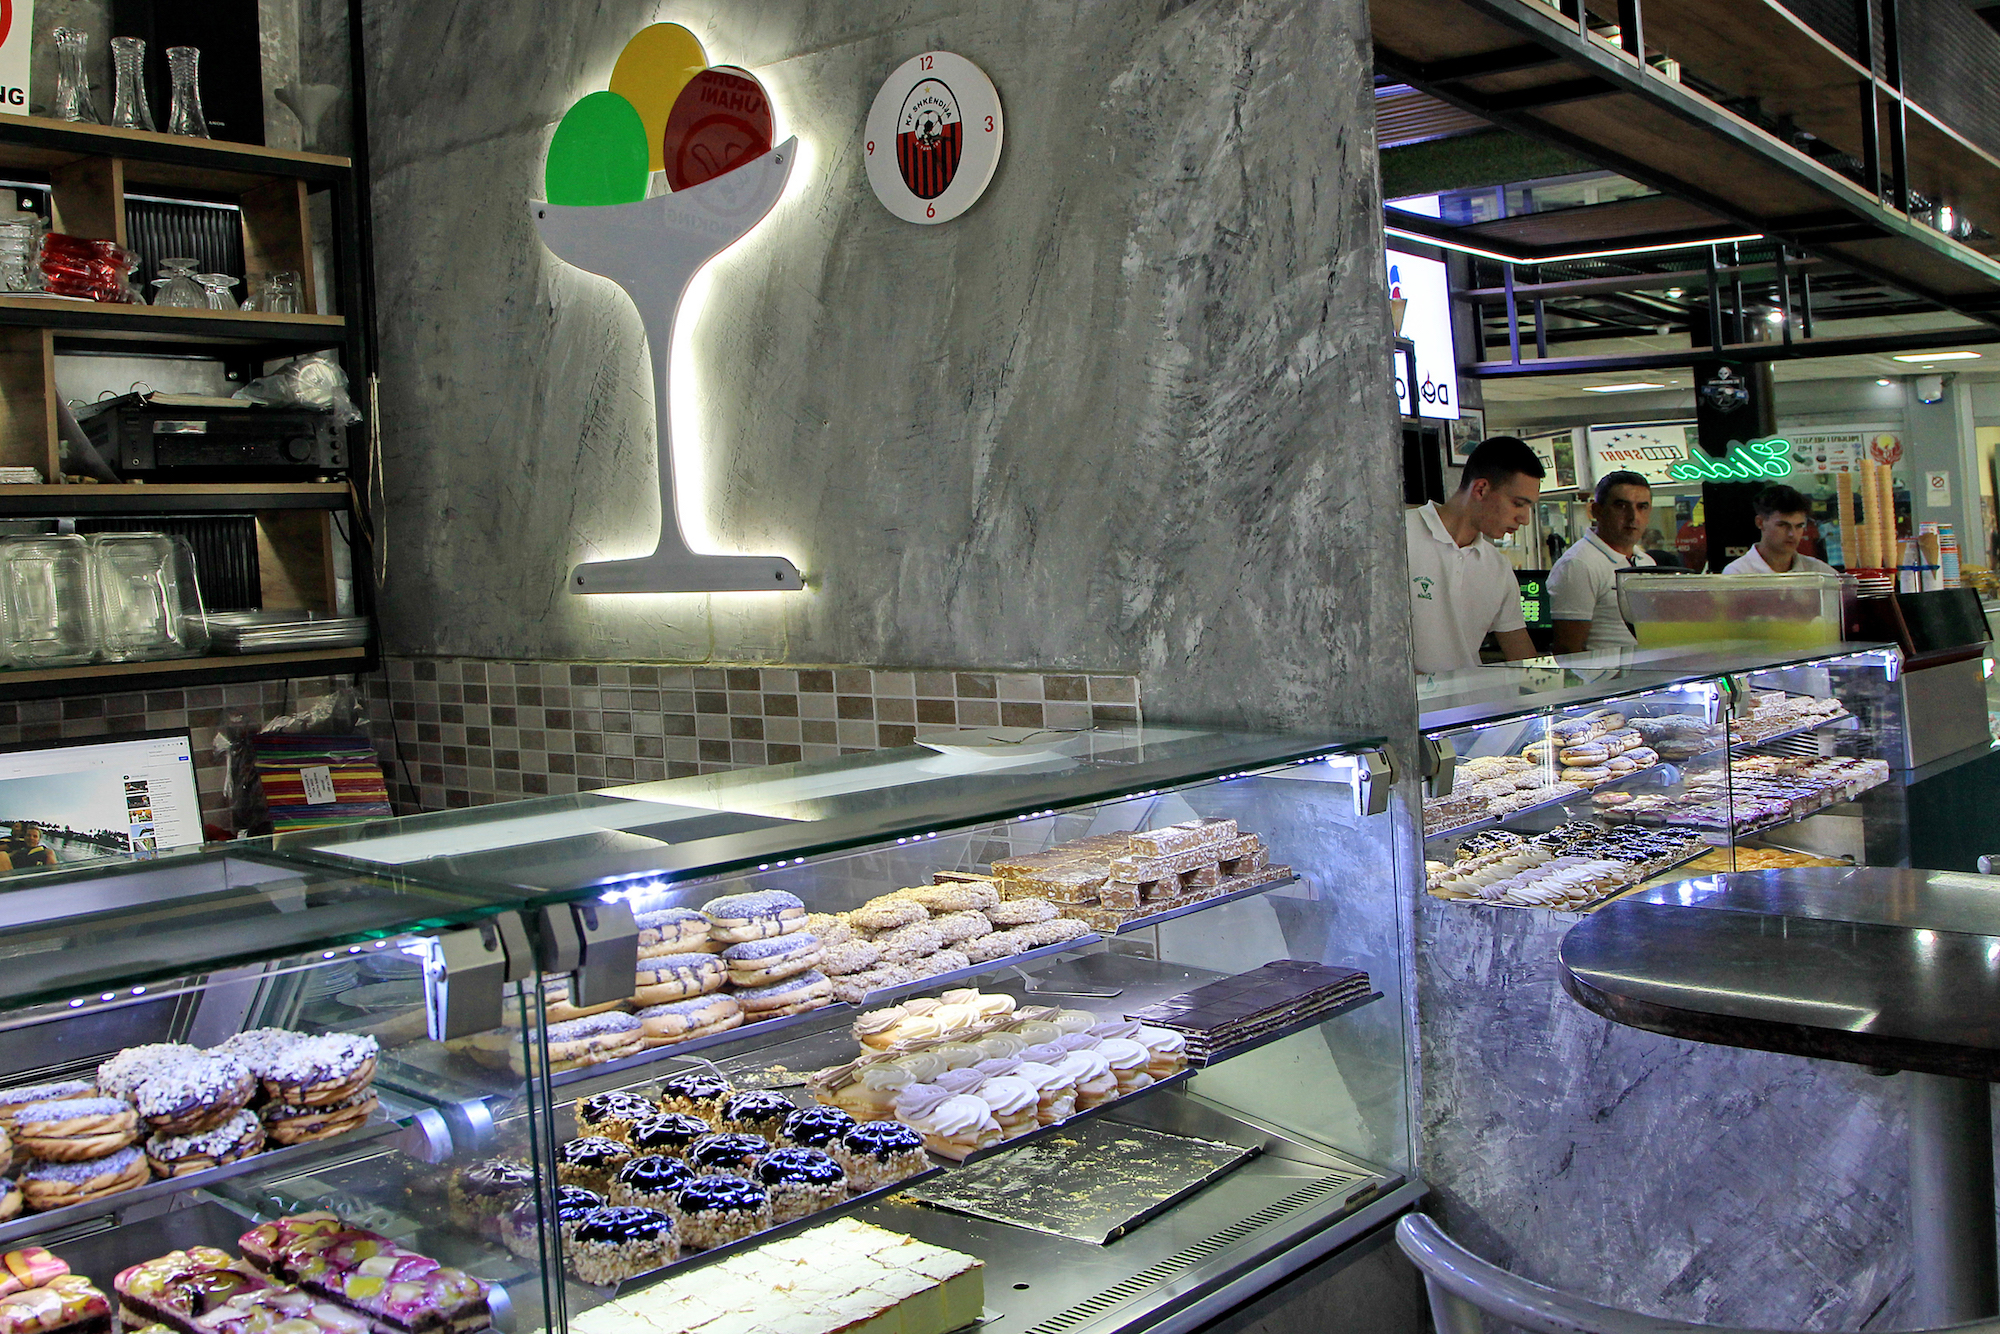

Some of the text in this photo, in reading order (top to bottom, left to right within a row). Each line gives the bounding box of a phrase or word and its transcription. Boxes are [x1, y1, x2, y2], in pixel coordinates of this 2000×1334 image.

[920, 55, 933, 71] 12
[905, 96, 952, 126] KF SHKËNDIJA
[984, 115, 994, 132] 3
[866, 140, 875, 155] 9
[926, 202, 935, 218] 6
